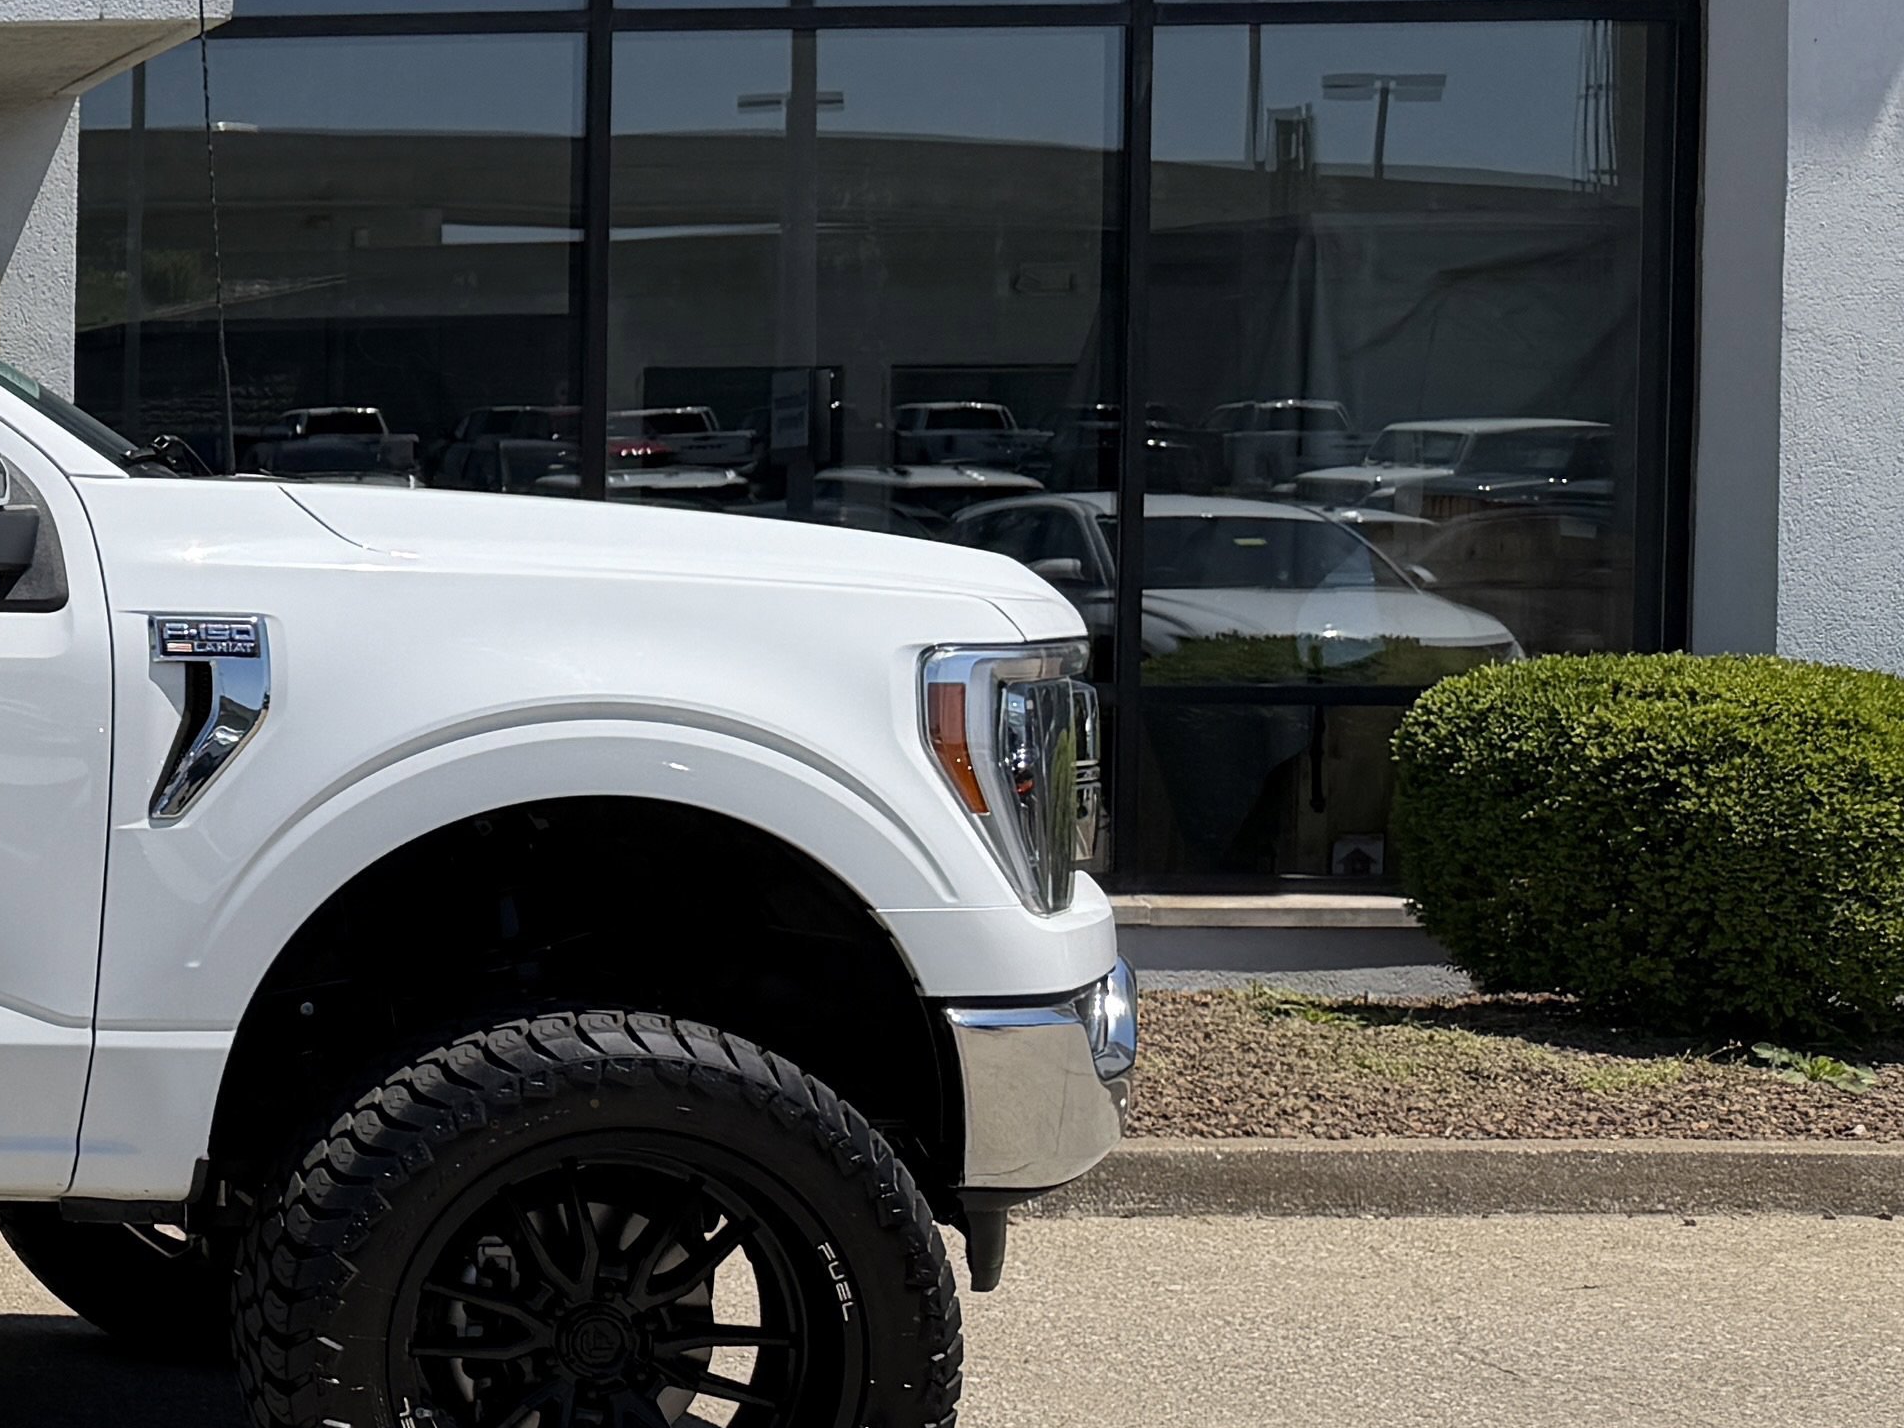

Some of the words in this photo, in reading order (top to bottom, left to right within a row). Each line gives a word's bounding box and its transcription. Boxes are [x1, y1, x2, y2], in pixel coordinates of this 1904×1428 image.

[163, 622, 257, 641] F-150
[194, 641, 256, 654] LARIAT
[816, 1240, 855, 1323] FUEL
